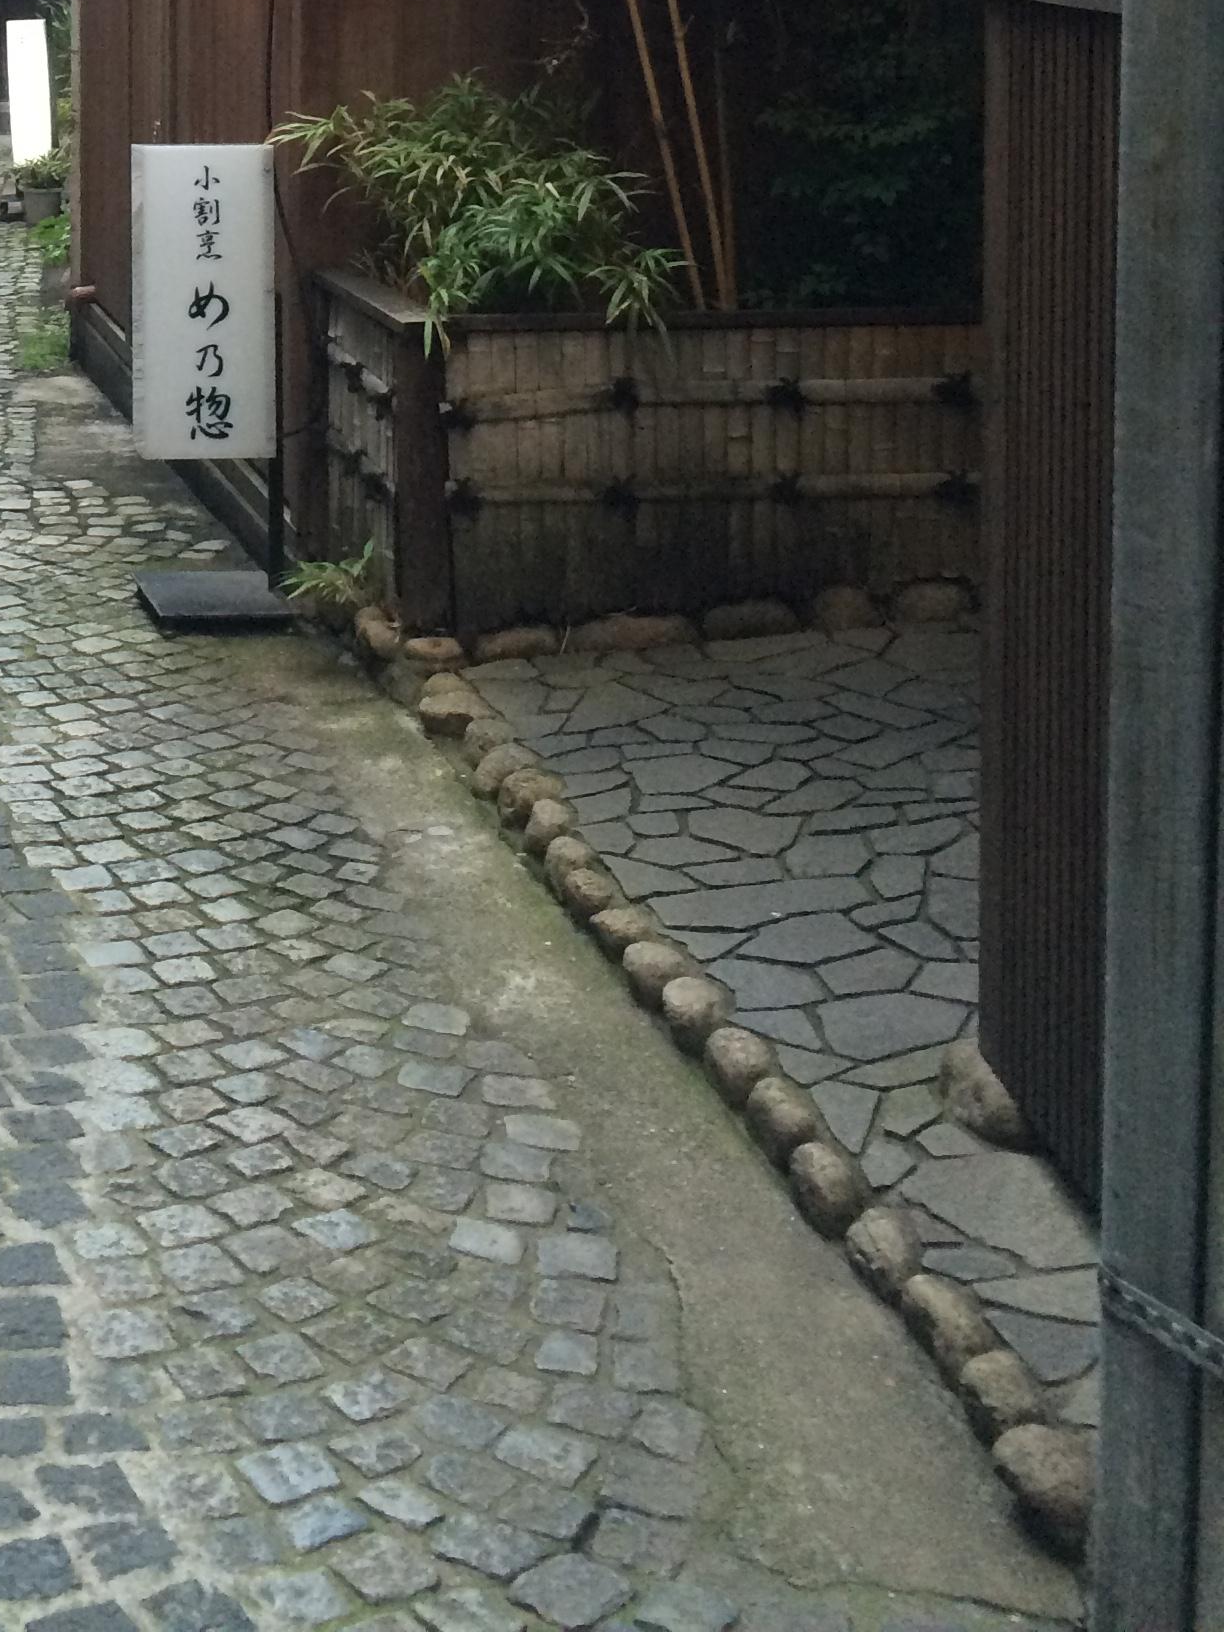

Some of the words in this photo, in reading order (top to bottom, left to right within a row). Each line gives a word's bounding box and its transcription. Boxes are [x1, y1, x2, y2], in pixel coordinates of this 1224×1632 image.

[193, 165, 223, 261] 小割烹
[185, 280, 234, 441] め乃惣
